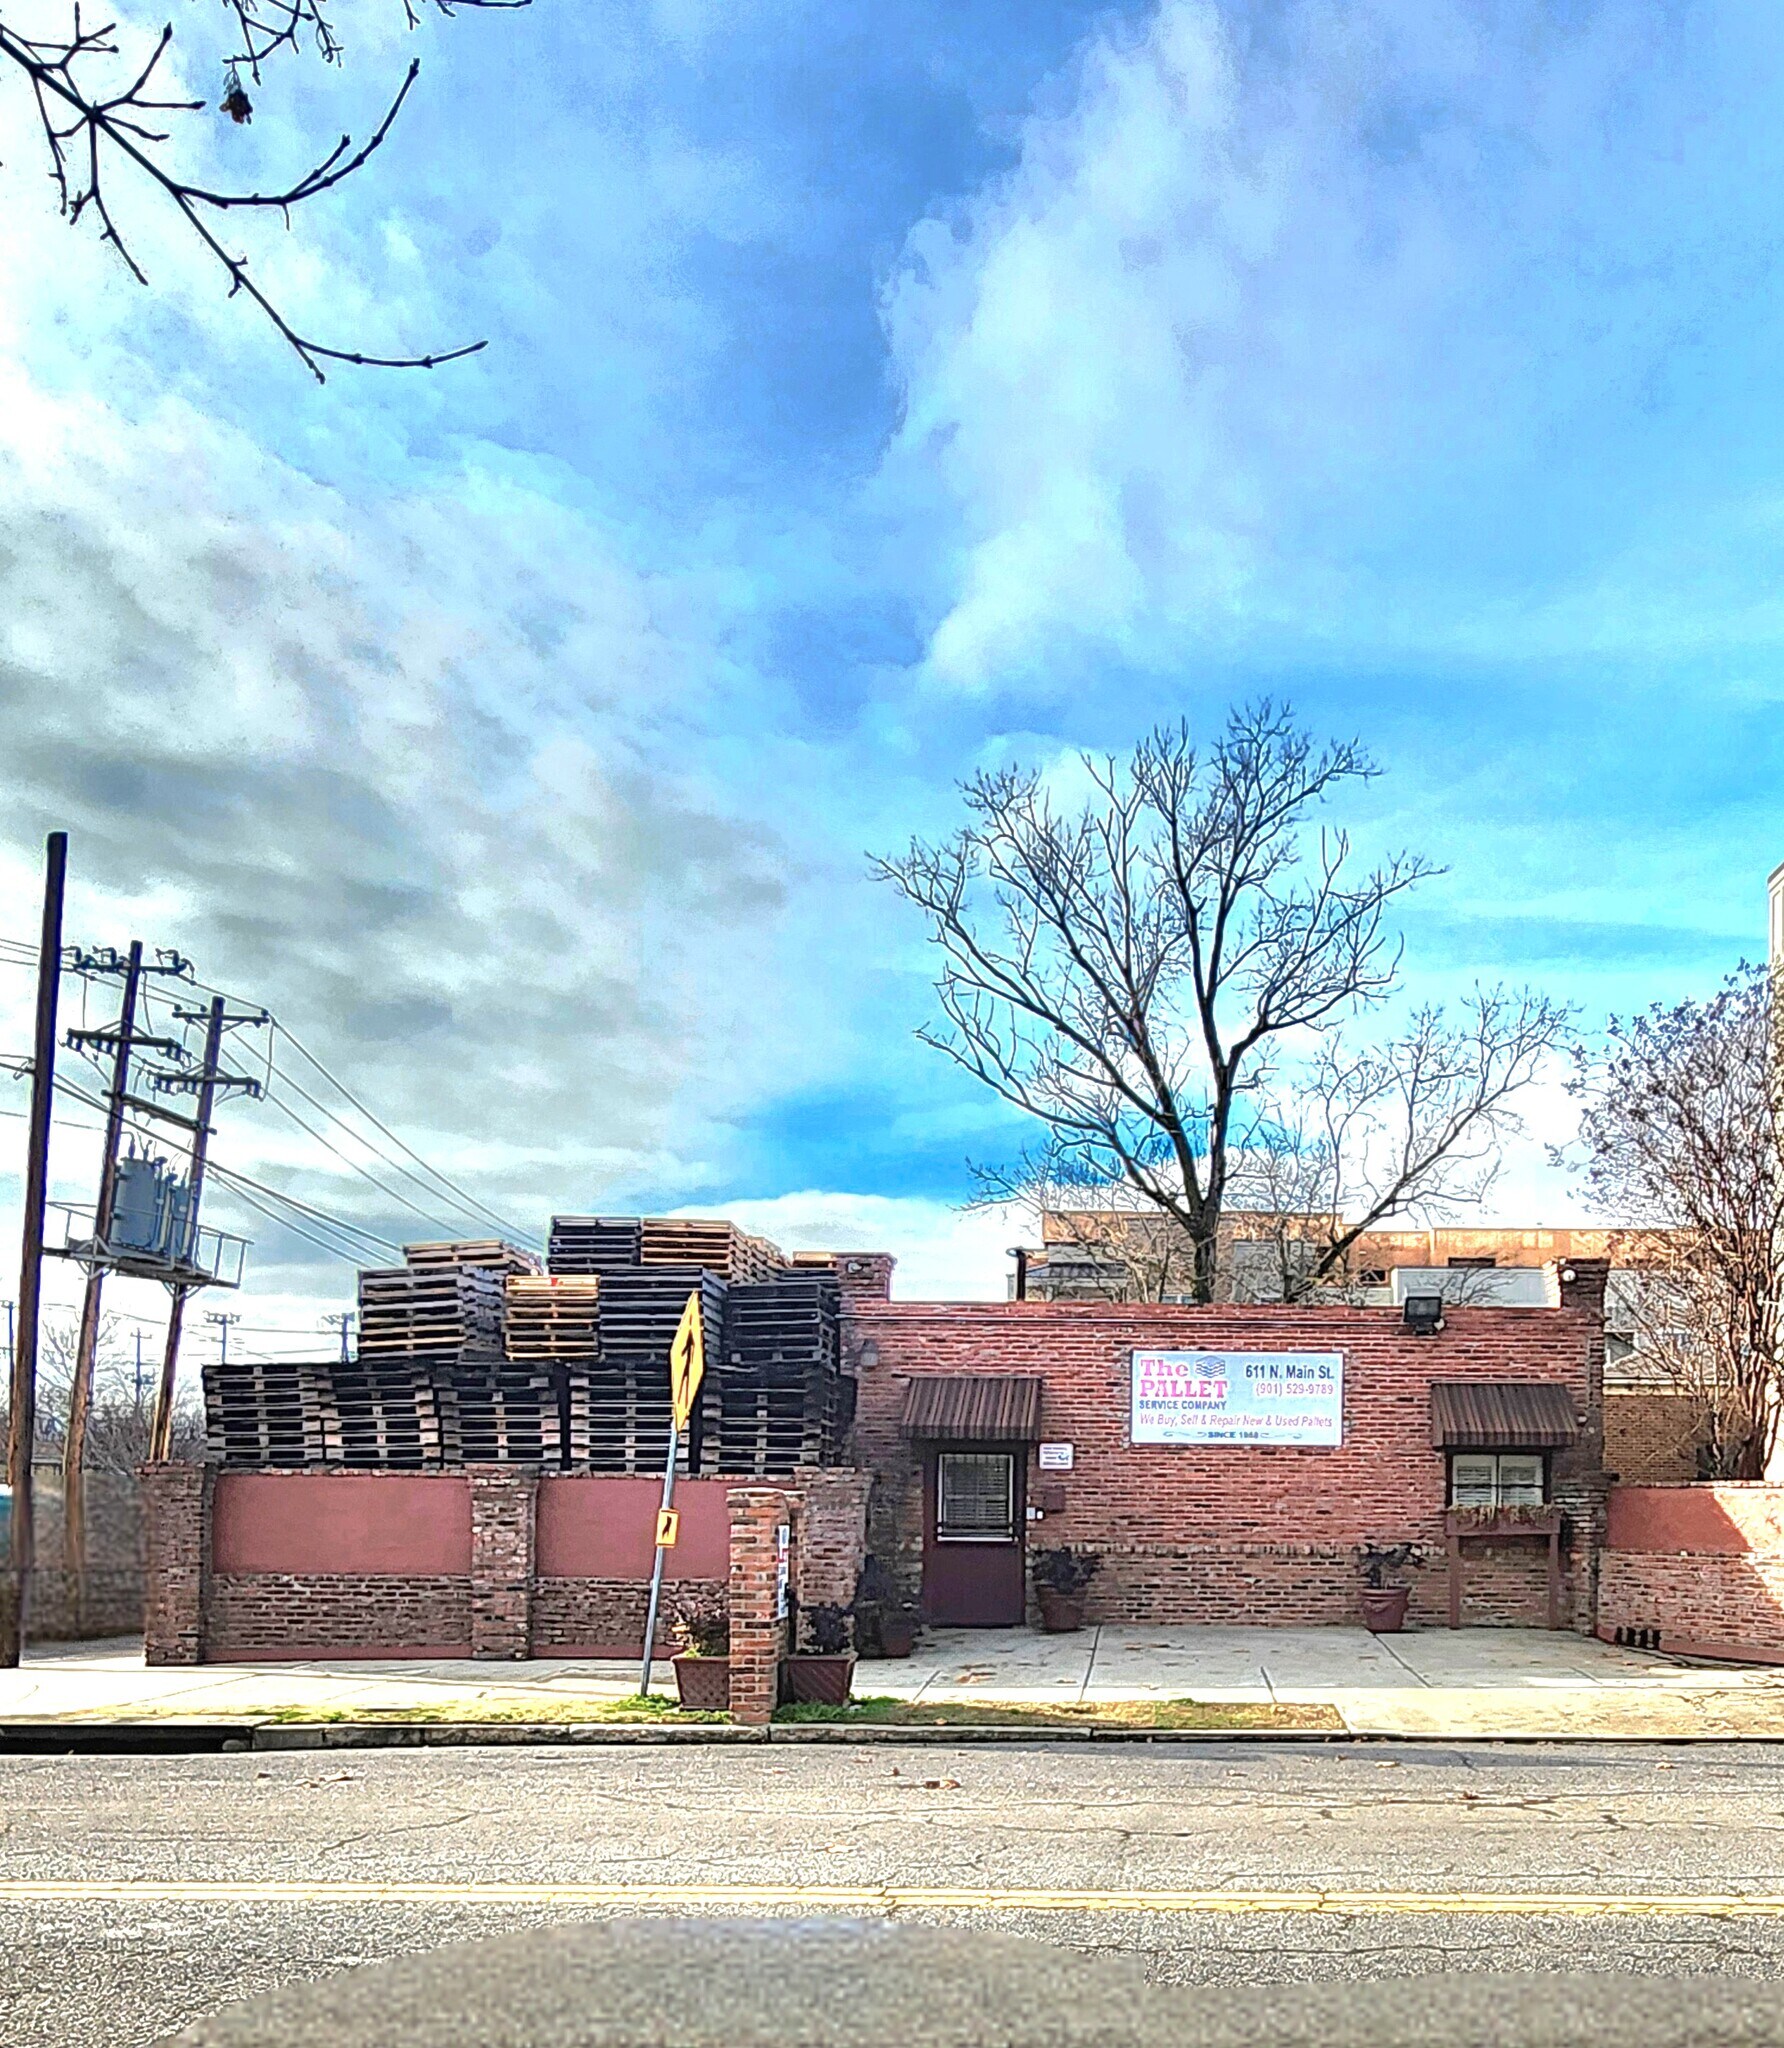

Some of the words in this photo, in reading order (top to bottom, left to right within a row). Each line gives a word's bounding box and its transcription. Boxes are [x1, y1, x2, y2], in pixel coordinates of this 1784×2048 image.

[1140, 1359, 1189, 1377] The
[1245, 1364, 1266, 1379] 611
[1269, 1364, 1283, 1379] N.
[1286, 1364, 1315, 1379] Main
[1139, 1379, 1228, 1398] PALLET
[1256, 1383, 1283, 1397] (901)
[1286, 1383, 1334, 1395] 529-9789
[1139, 1399, 1179, 1410] SERVICE
[1181, 1400, 1228, 1411] COMPANY
[1140, 1412, 1155, 1425] We
[1157, 1413, 1178, 1427] Buy,
[1180, 1413, 1199, 1425] Sell
[1200, 1414, 1207, 1425] &
[1209, 1414, 1241, 1428] Repair
[1242, 1415, 1264, 1426] New
[1265, 1415, 1272, 1426] &
[1275, 1415, 1300, 1426] Used
[1301, 1416, 1333, 1427] Pallets
